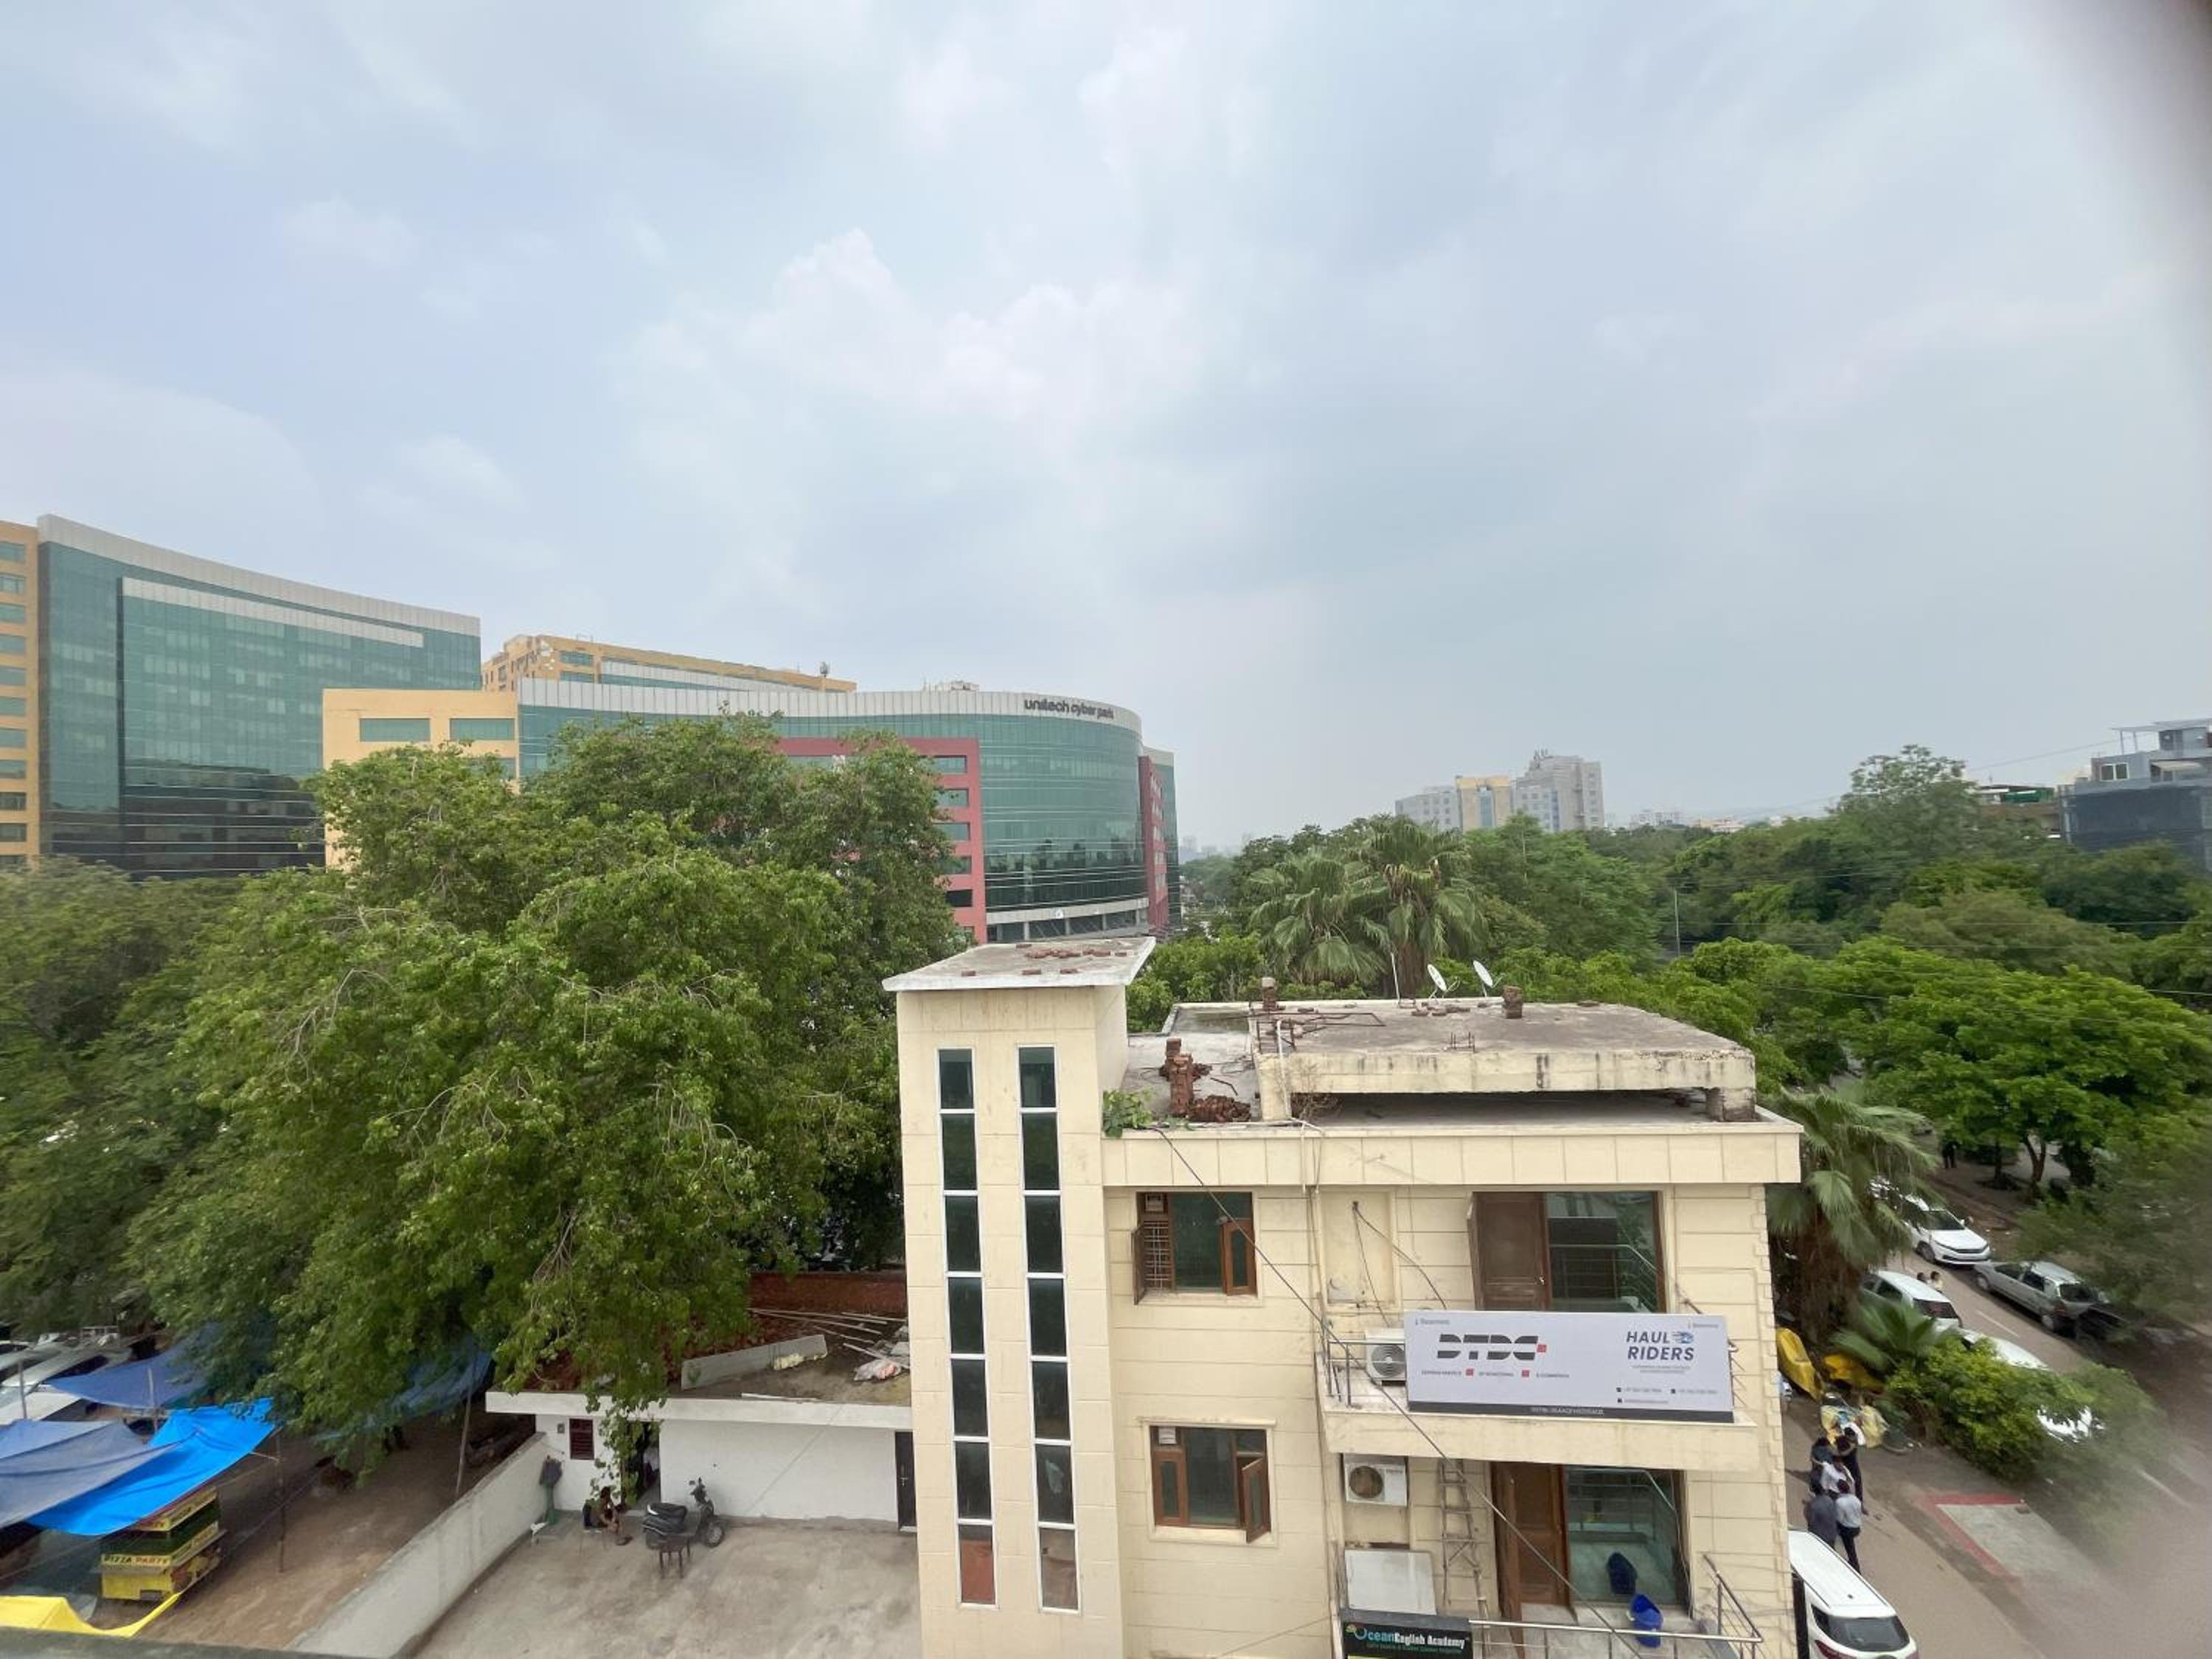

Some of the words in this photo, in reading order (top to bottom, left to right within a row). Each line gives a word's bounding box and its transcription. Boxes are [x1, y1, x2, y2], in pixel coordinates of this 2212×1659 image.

[1024, 699, 1069, 712] unitech
[1627, 1331, 1670, 1343] HAUL
[1437, 1334, 1539, 1360] DTDC
[1627, 1346, 1694, 1360] RIDERS
[1427, 1635, 1465, 1649] Academy
